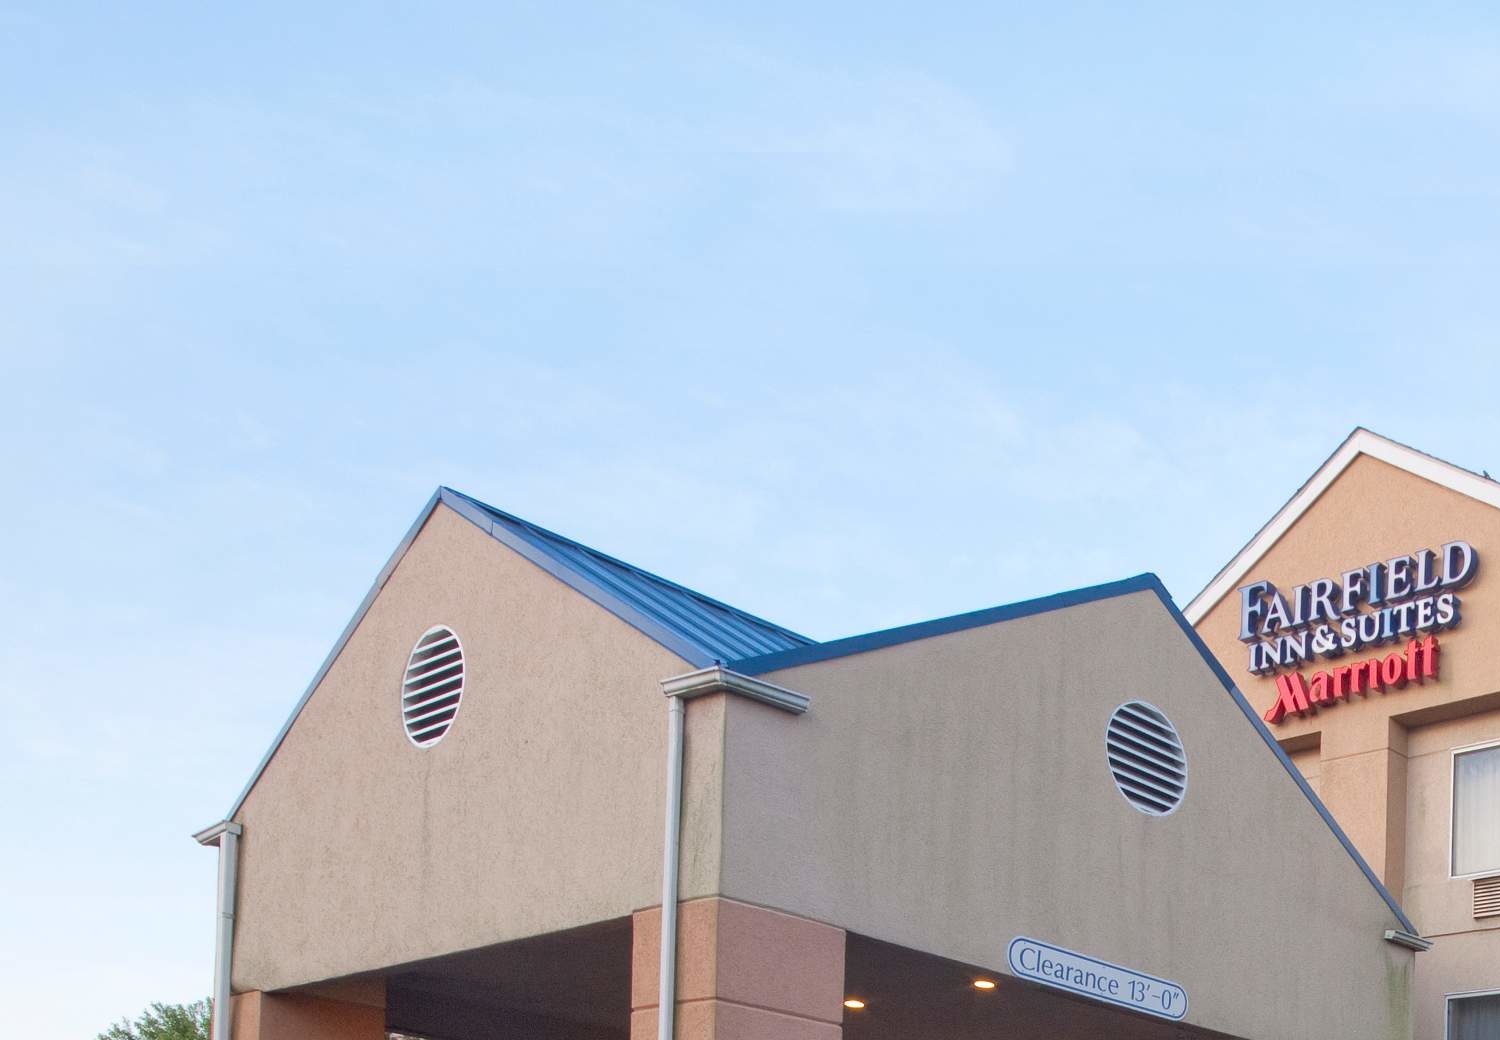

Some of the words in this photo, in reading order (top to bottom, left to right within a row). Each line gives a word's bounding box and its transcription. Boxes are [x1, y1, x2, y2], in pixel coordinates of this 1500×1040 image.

[1238, 541, 1477, 641] FAIRFIELD
[1264, 635, 1439, 723] Marriott
[1019, 947, 1119, 996] Clearance
